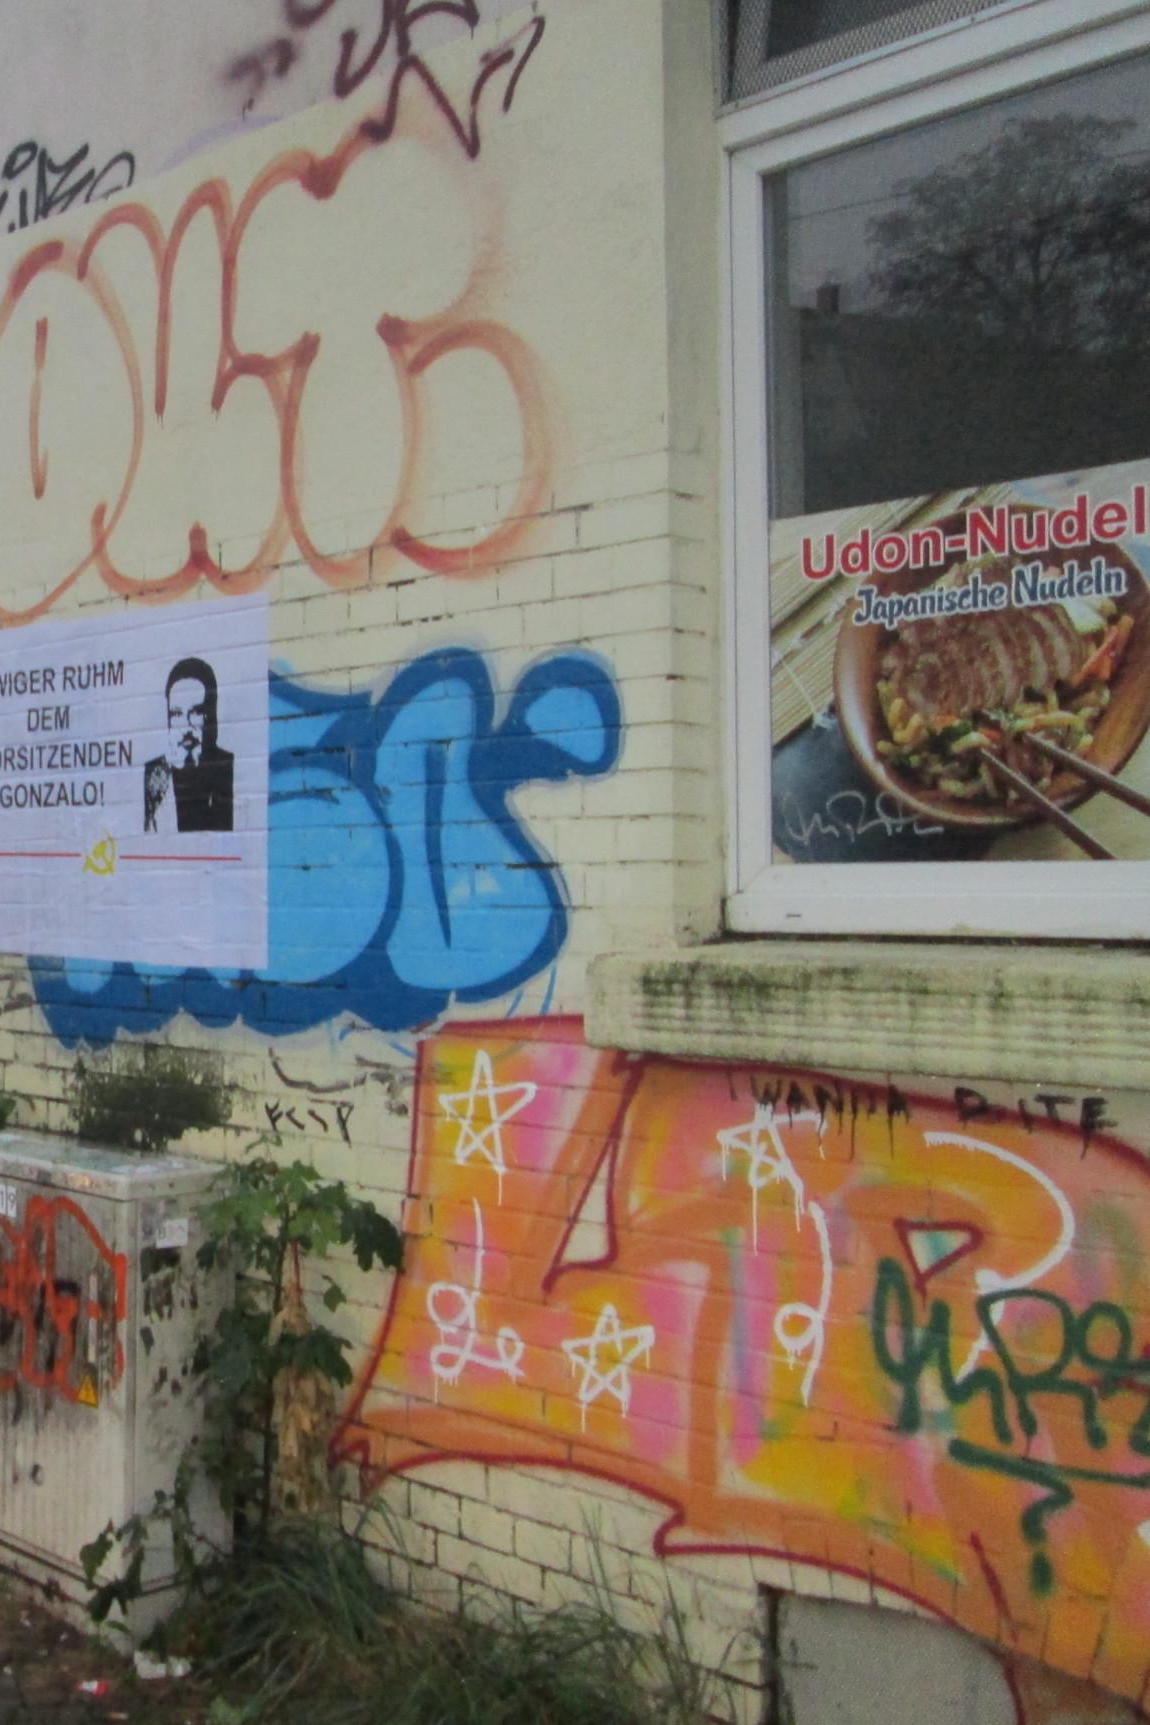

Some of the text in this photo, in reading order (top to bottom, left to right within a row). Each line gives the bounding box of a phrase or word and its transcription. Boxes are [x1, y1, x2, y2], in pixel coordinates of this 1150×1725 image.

[801, 484, 1147, 580] Udon-Nudel
[853, 557, 1127, 628] Japanische Nudeln
[62, 660, 125, 691] RUHM
[26, 706, 70, 733] DEM
[0, 781, 105, 809] GONZALO!
